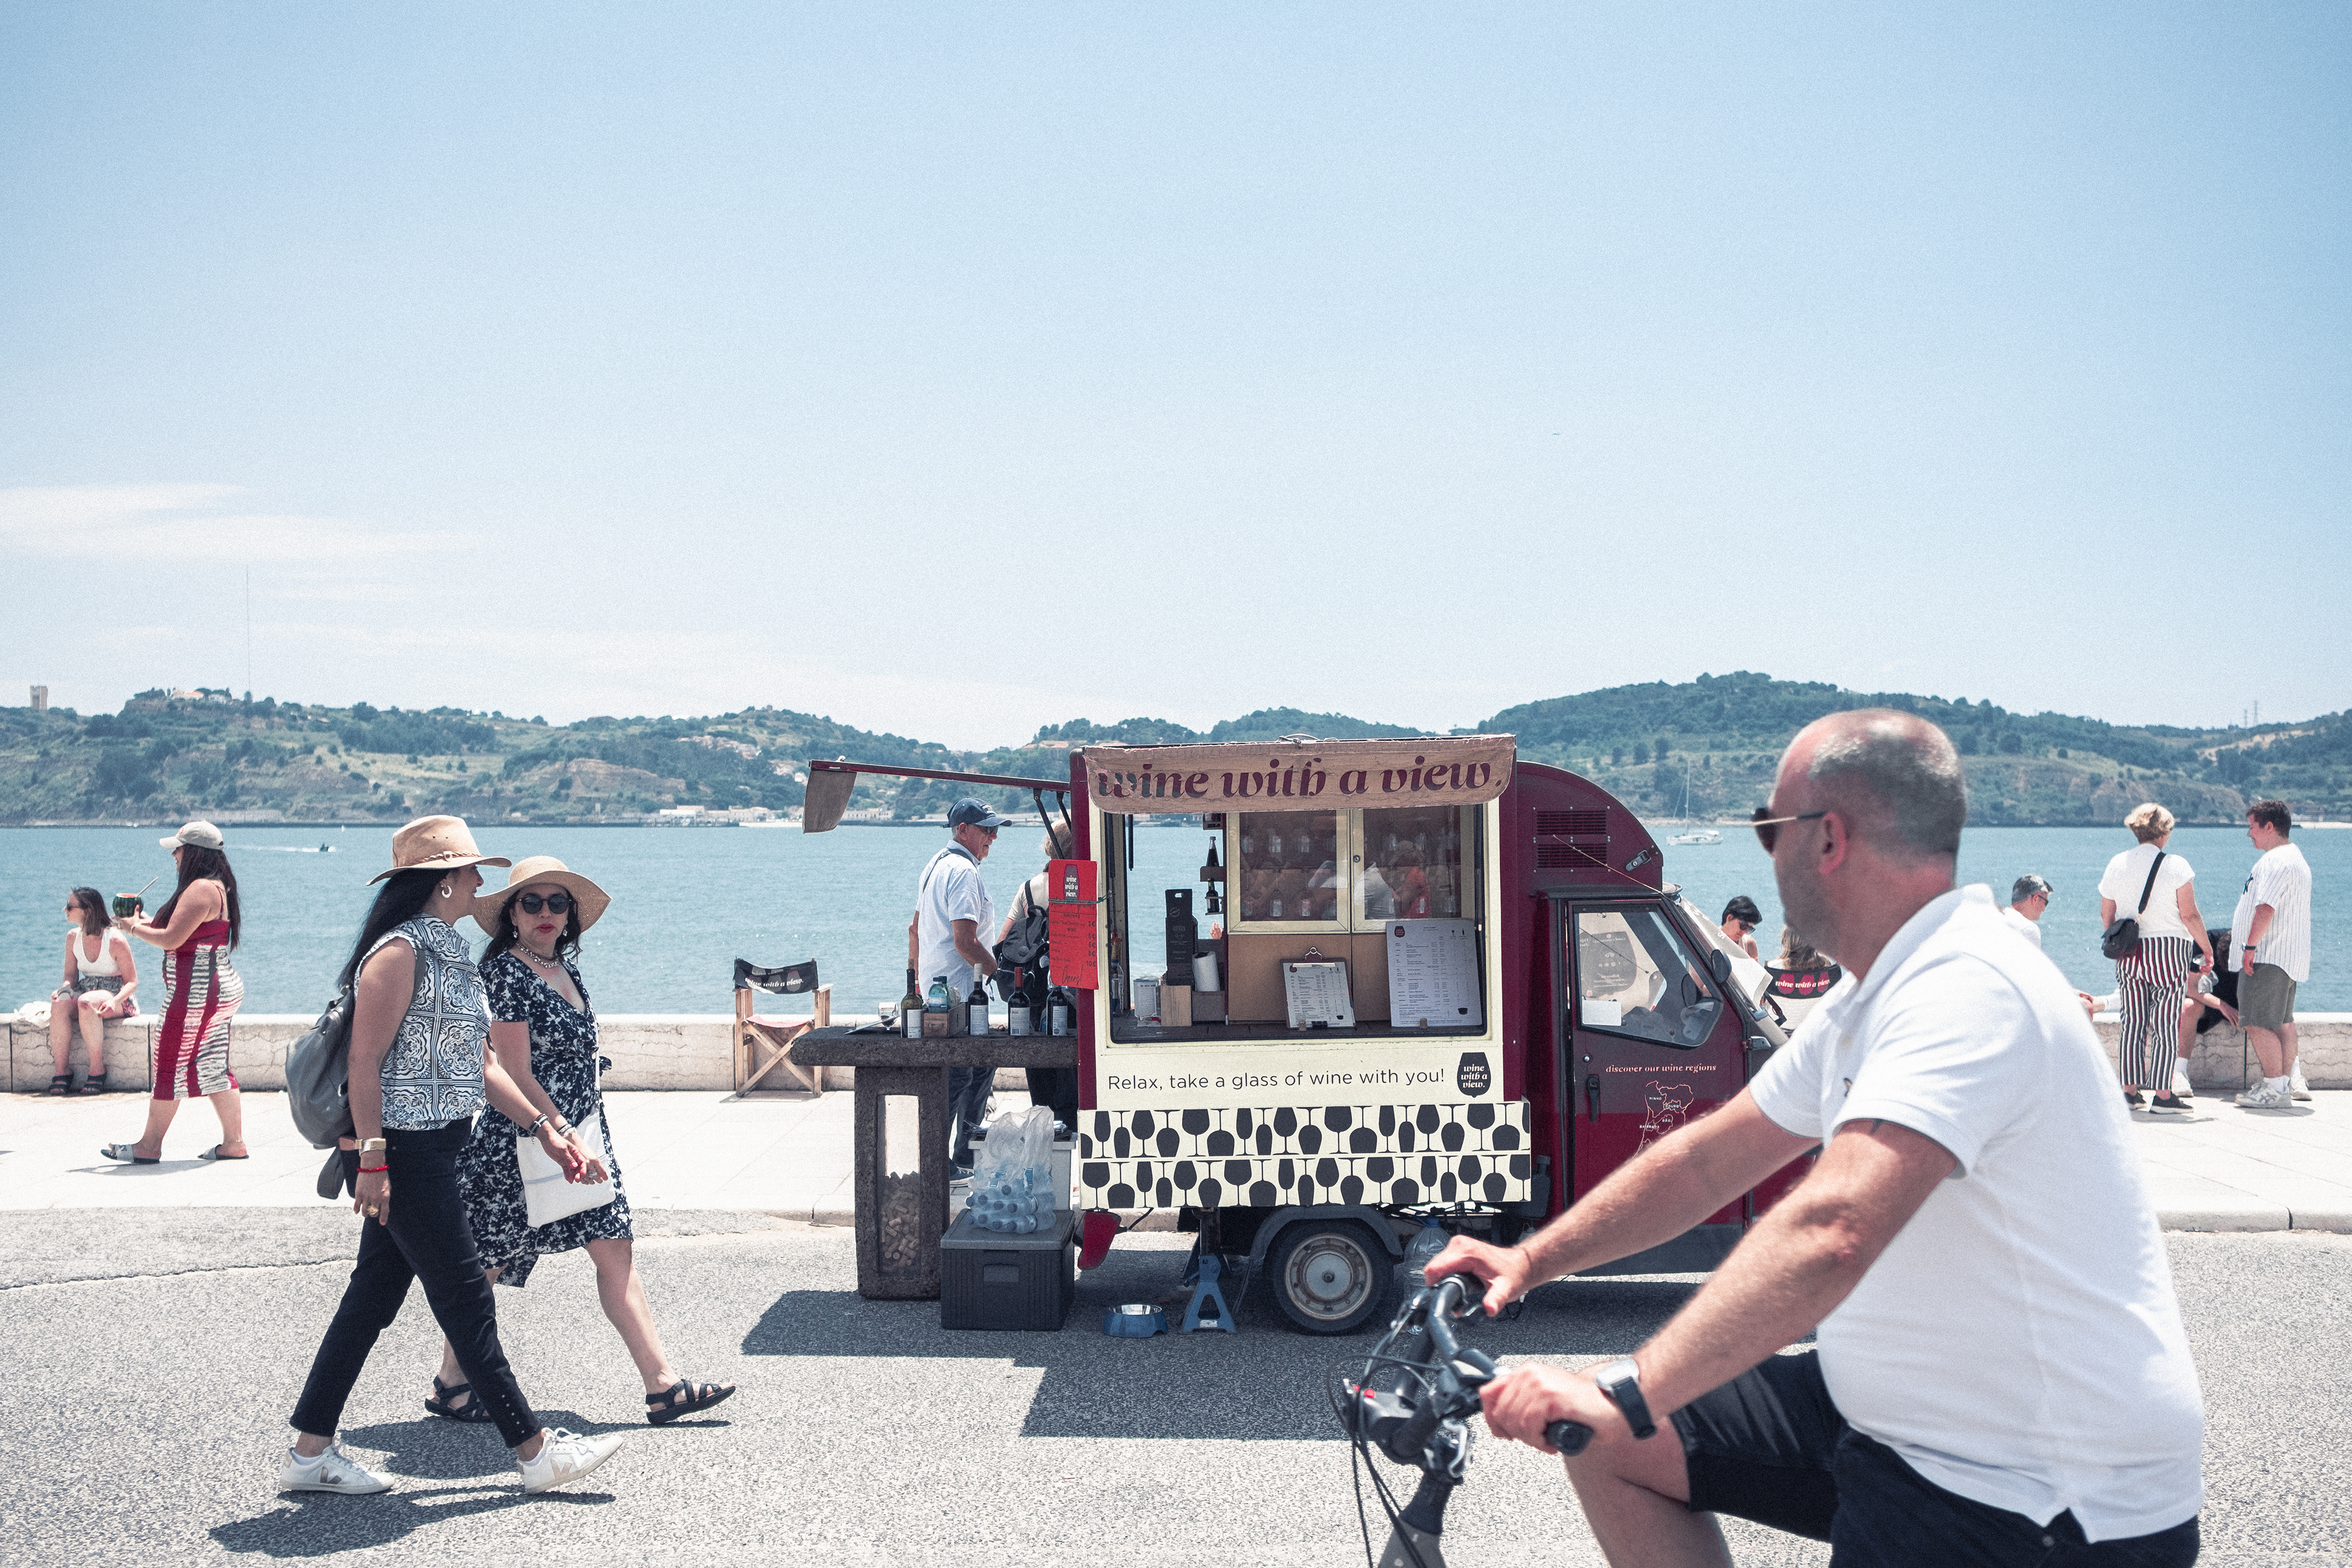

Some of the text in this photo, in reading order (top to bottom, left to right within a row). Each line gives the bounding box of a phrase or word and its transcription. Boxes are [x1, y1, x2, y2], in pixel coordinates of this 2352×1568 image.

[1096, 755, 1502, 798] wine with a view.
[1109, 1068, 1444, 1091] Relax, take a glass of wine with you!
[1662, 1063, 1683, 1072] wine
[1685, 1063, 1716, 1073] regions
